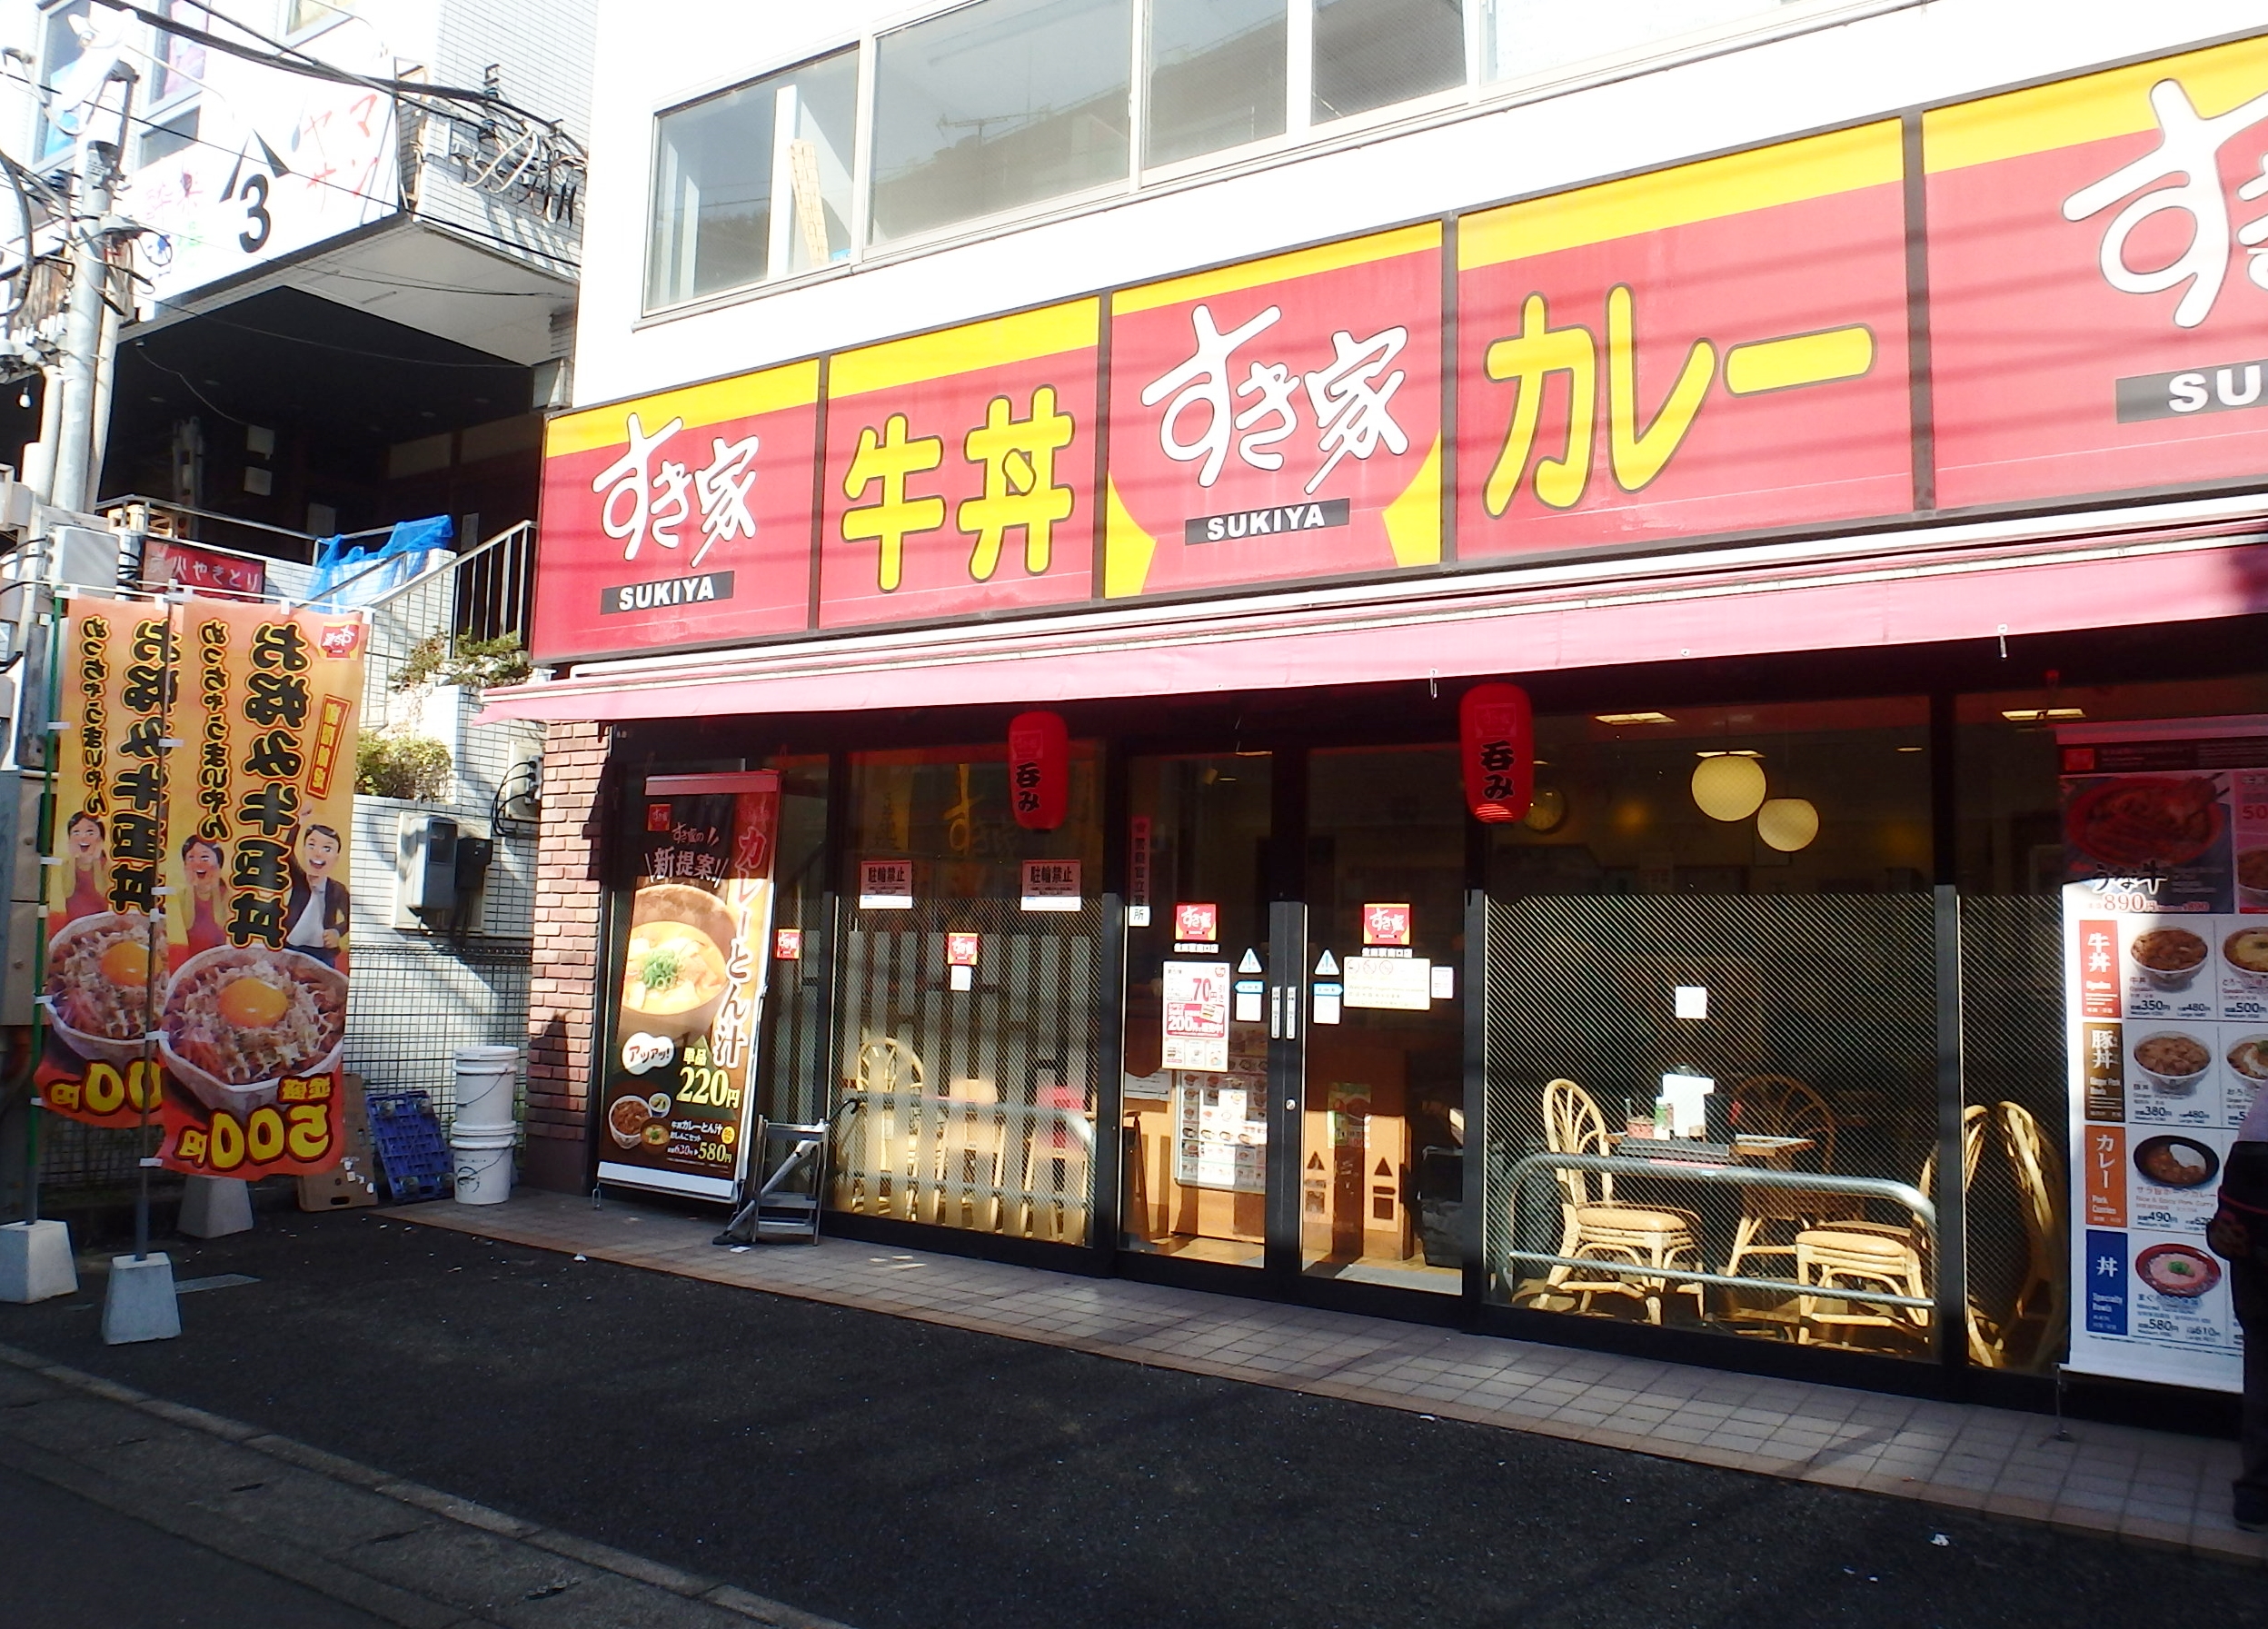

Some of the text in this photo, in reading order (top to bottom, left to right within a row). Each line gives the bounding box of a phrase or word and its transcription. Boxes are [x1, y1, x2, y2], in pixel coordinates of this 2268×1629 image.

[239, 174, 271, 253] 3
[1140, 303, 1410, 495] すき家
[1483, 282, 1876, 520] カレー
[592, 412, 759, 568] すき家
[841, 384, 1075, 592] 牛丼
[1207, 504, 1326, 541] SUKIYA
[619, 576, 714, 611] SUKIYA
[1016, 762, 1041, 812] 呑み
[1480, 740, 1515, 800] 呑み
[868, 867, 905, 882] 駐輪禁止
[1030, 866, 1073, 883] 駐輪禁止
[1181, 908, 1212, 929] すき家
[1369, 908, 1405, 933] すき家
[2104, 894, 2156, 911] 890円
[712, 827, 767, 1068] カレーとん汁
[2087, 932, 2111, 973] 牛丼
[683, 1048, 707, 1066] 単品
[2091, 1029, 2114, 1069] 豚丼
[676, 1068, 740, 1108] 220円
[698, 1142, 731, 1163] 580円
[2096, 1134, 2114, 1188] カレー
[2096, 1257, 2119, 1278] 丼
